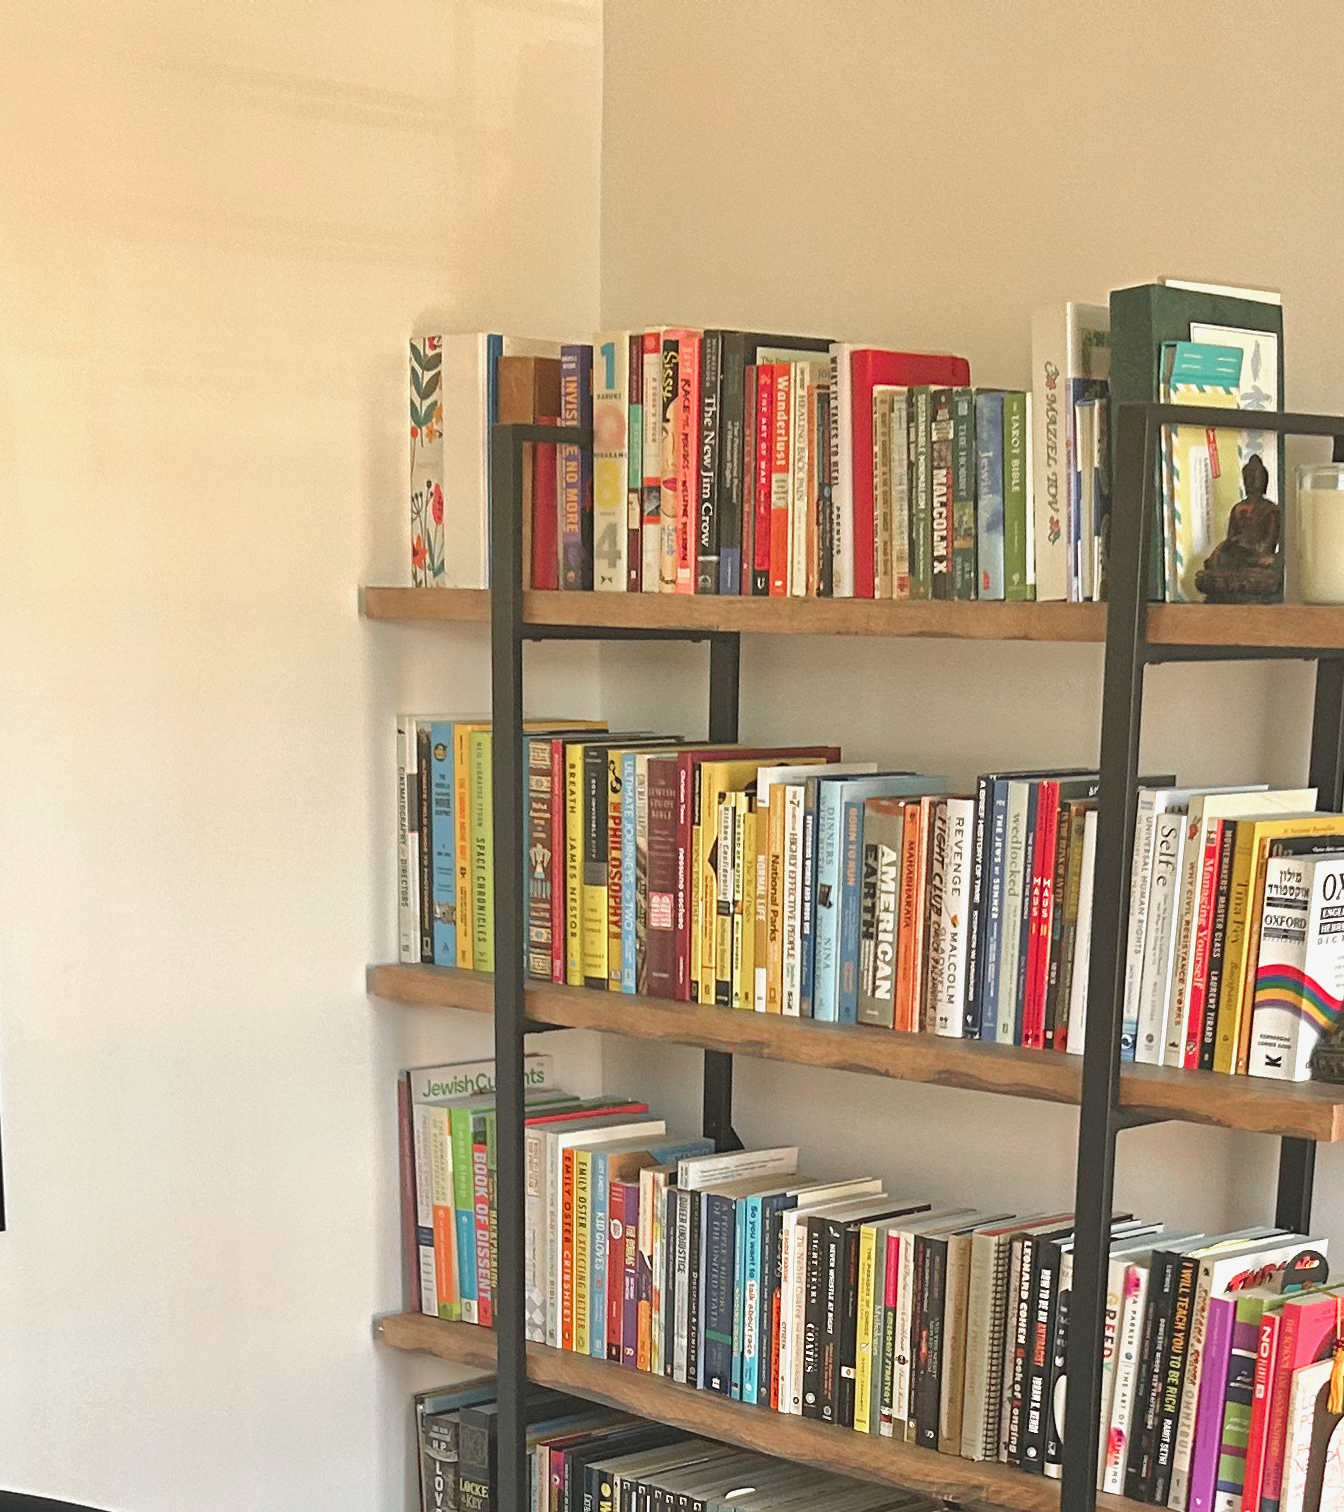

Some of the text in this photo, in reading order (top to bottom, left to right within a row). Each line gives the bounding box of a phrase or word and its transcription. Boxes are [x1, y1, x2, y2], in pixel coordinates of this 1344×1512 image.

[566, 376, 578, 455] INVISIE
[663, 351, 679, 402] Sissy
[776, 375, 789, 466] Wanderlust
[1011, 414, 1020, 493] TAROT BIBLE
[566, 461, 578, 483] NO
[566, 488, 578, 532] MORE
[701, 395, 715, 547] The New Jim Crow
[933, 469, 947, 574] MALCOLM X
[476, 837, 486, 943] SPACE CHRONICLES
[757, 855, 766, 921] NORMAL LIFE
[862, 844, 877, 941] EARTH
[904, 840, 914, 929] MAHABHARATA
[931, 815, 945, 917] FIGHT CLUB
[952, 817, 964, 897] REVENGE
[1008, 812, 1022, 898] wedlocked
[1279, 868, 1302, 882] מילון
[769, 854, 780, 943] National Parks
[875, 844, 897, 1000] AMERICAN
[1193, 858, 1214, 990] Managing Yourself
[1264, 914, 1306, 929] OXFORD
[947, 932, 957, 1004] MALCOLM
[423, 1068, 545, 1098] JewishCunts
[473, 1151, 491, 1301] BOOK OF DISSENT
[595, 1211, 606, 1271] KID GLOVES
[751, 1205, 758, 1218] So
[749, 1267, 755, 1278] to
[805, 1323, 815, 1373] COATES
[1009, 1240, 1032, 1454] LEONARD COHEN Book of Longing
[1260, 1325, 1271, 1358] NO
[460, 1478, 488, 1499] LOCKE
